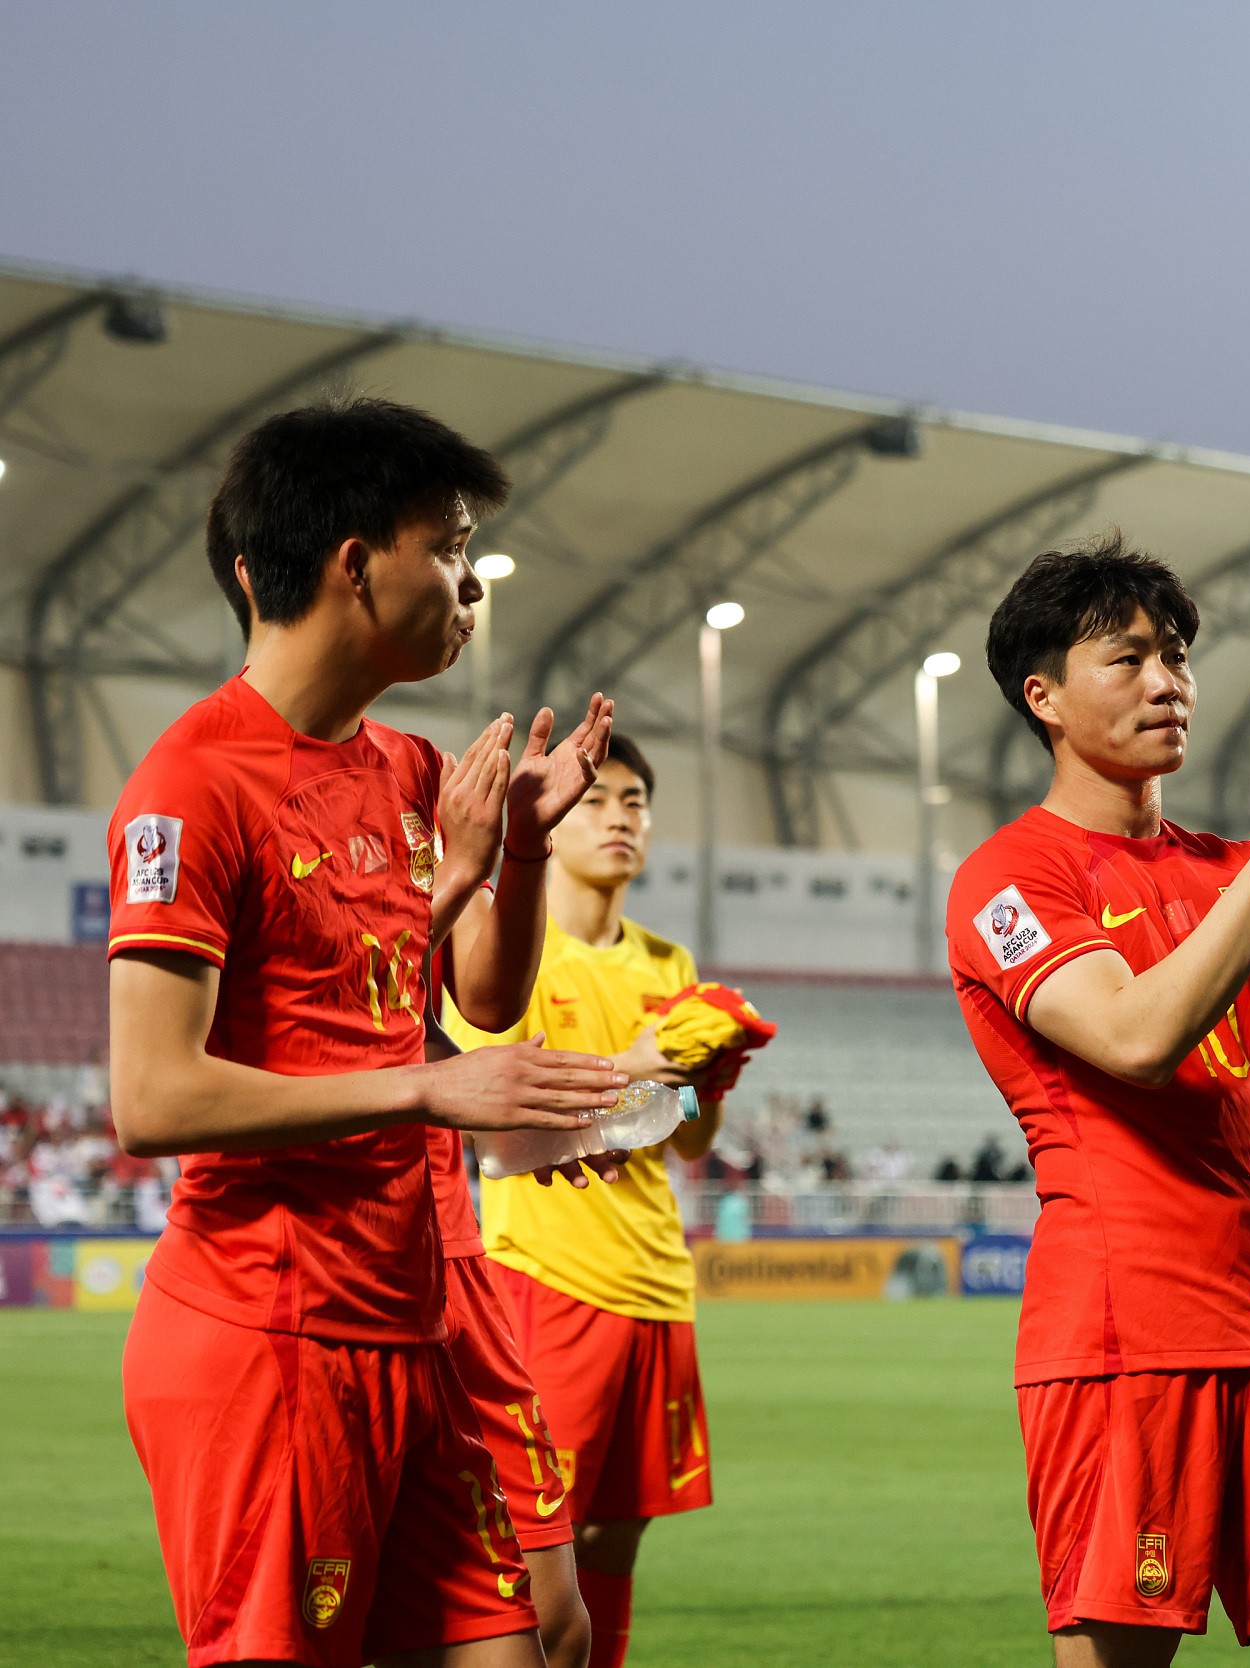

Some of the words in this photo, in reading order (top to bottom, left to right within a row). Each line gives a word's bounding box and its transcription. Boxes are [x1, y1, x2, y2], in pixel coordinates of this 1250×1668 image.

[136, 868, 149, 877] AFC
[152, 876, 169, 885] CUP
[1002, 938, 1017, 953] AFC
[1016, 927, 1031, 941] U23
[1003, 944, 1024, 962] ASIAN
[1023, 930, 1038, 945] CUP
[1009, 948, 1025, 964] QATAR
[1138, 1538, 1163, 1550] CFA
[312, 1563, 347, 1576] CFA
